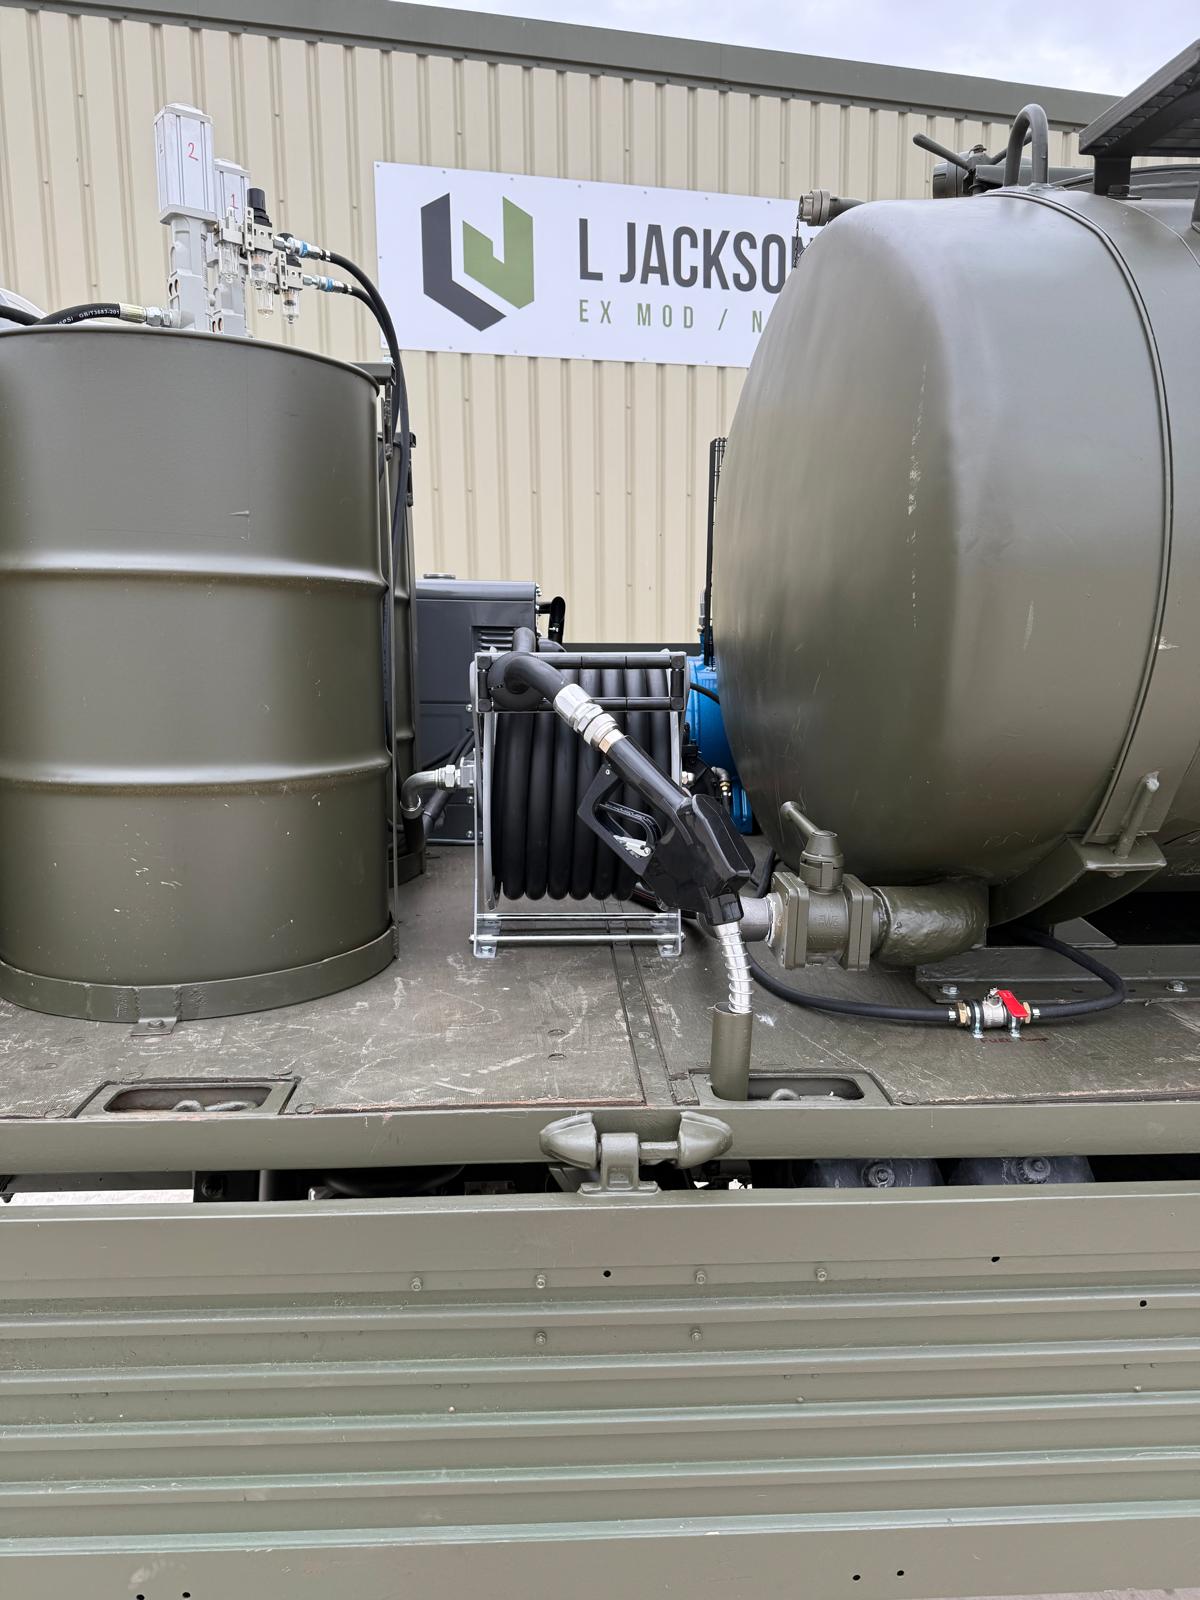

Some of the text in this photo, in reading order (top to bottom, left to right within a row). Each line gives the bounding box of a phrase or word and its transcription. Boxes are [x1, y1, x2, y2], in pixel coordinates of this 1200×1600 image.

[187, 142, 199, 161] 2
[231, 193, 239, 209] 1
[579, 218, 603, 281] L
[579, 299, 611, 324] EX
[637, 303, 694, 329] MOD
[718, 308, 728, 331] /
